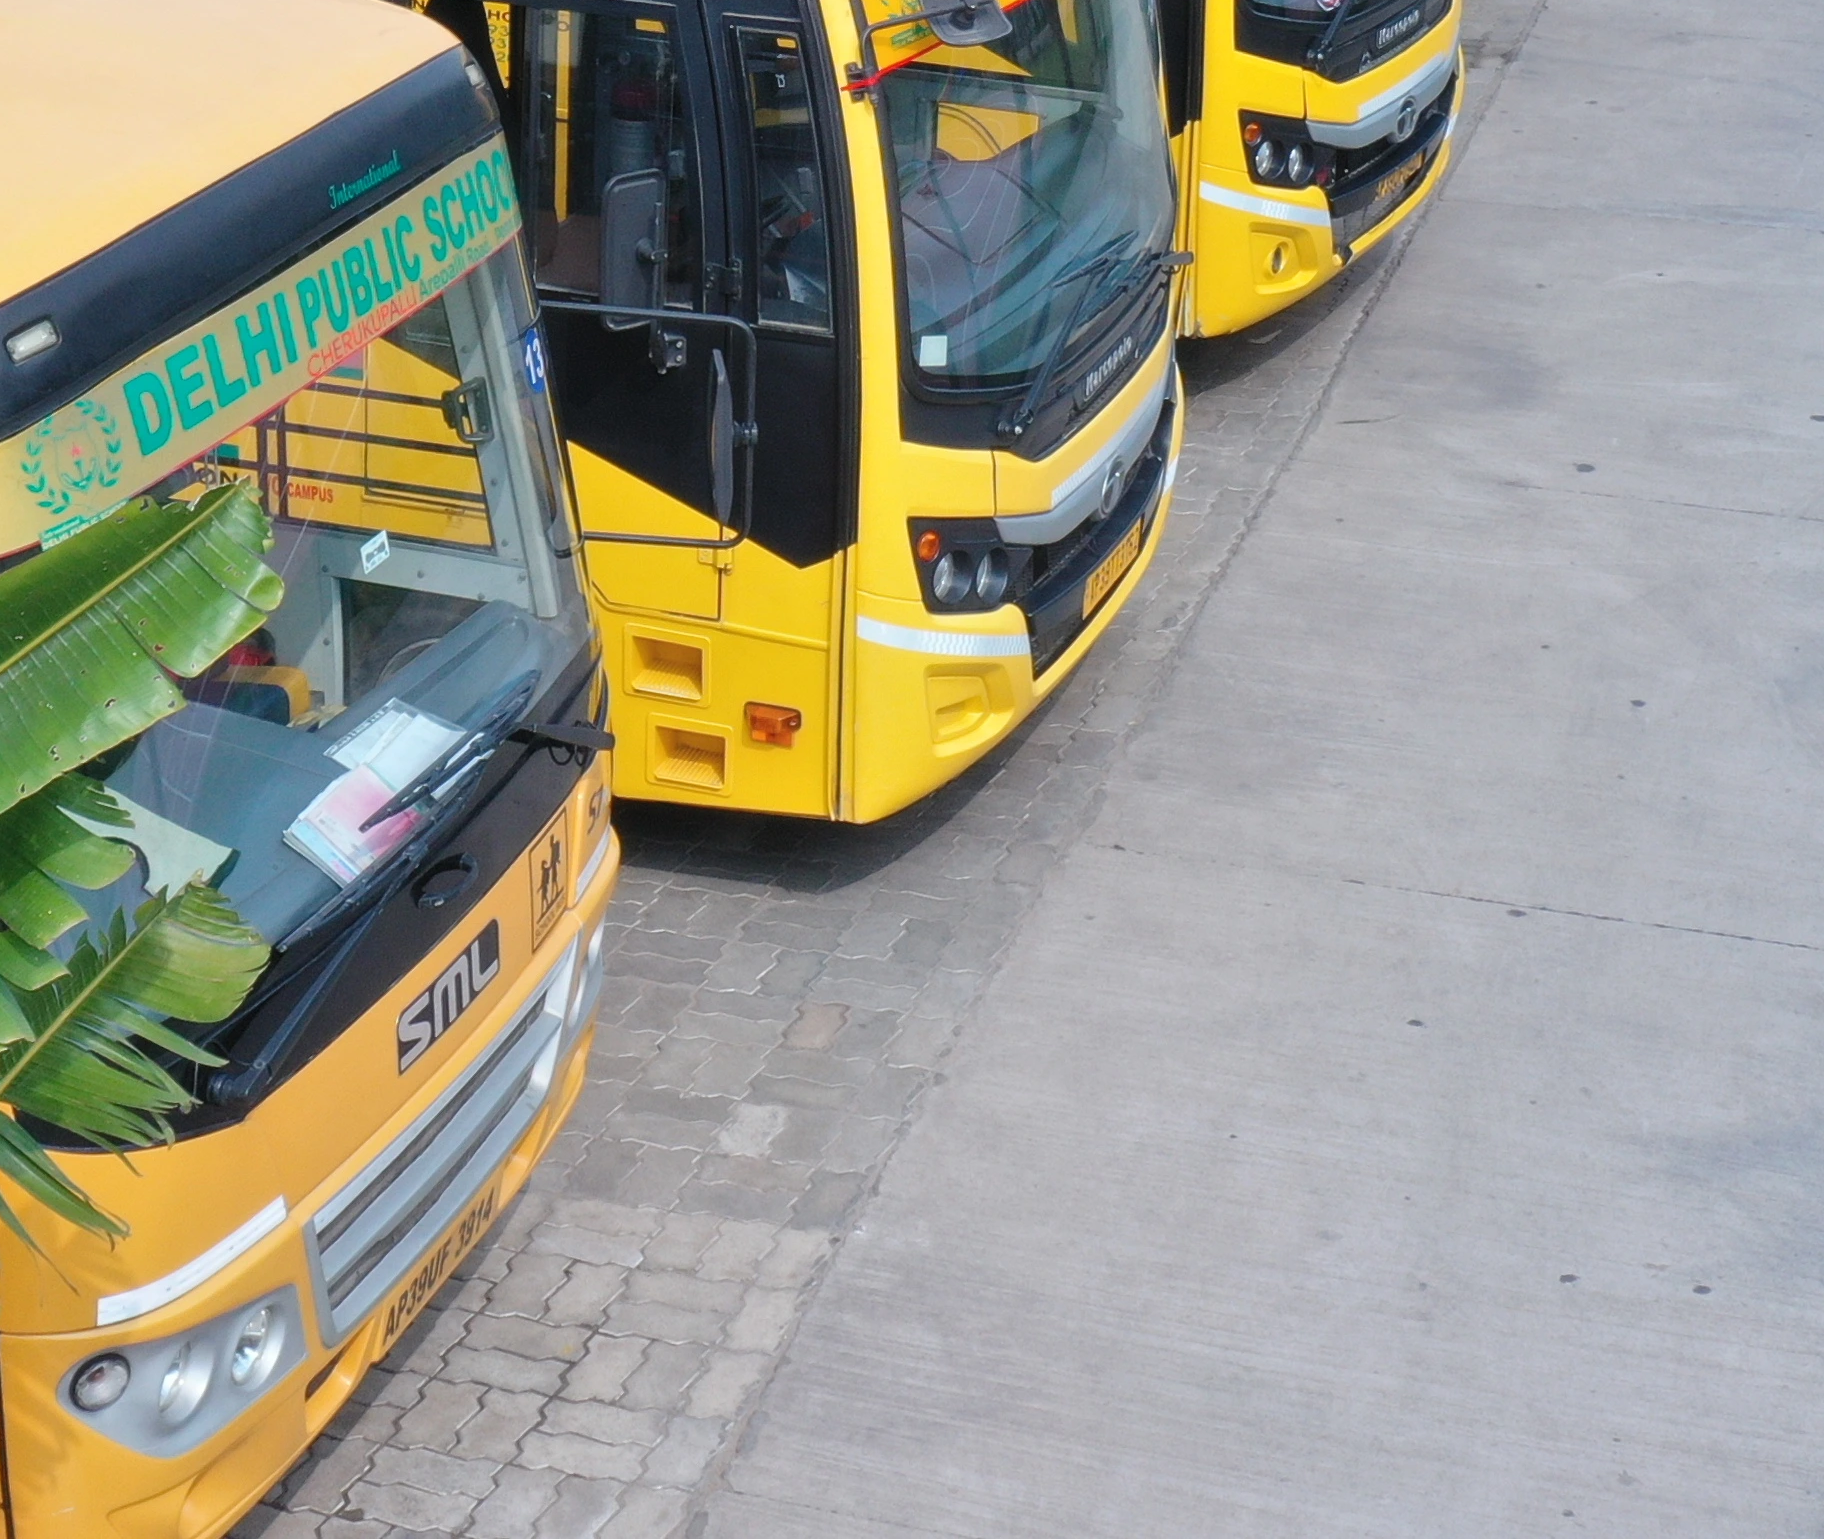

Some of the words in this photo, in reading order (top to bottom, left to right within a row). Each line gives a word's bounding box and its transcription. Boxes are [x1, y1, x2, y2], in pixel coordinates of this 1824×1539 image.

[328, 149, 402, 211] International
[122, 292, 299, 457] DELHI
[295, 215, 422, 349] PUBLIC
[306, 283, 419, 379] CHERUKUPALLI
[525, 337, 545, 385] 13
[287, 482, 334, 504] CAMPUS
[397, 938, 500, 1073] SML
